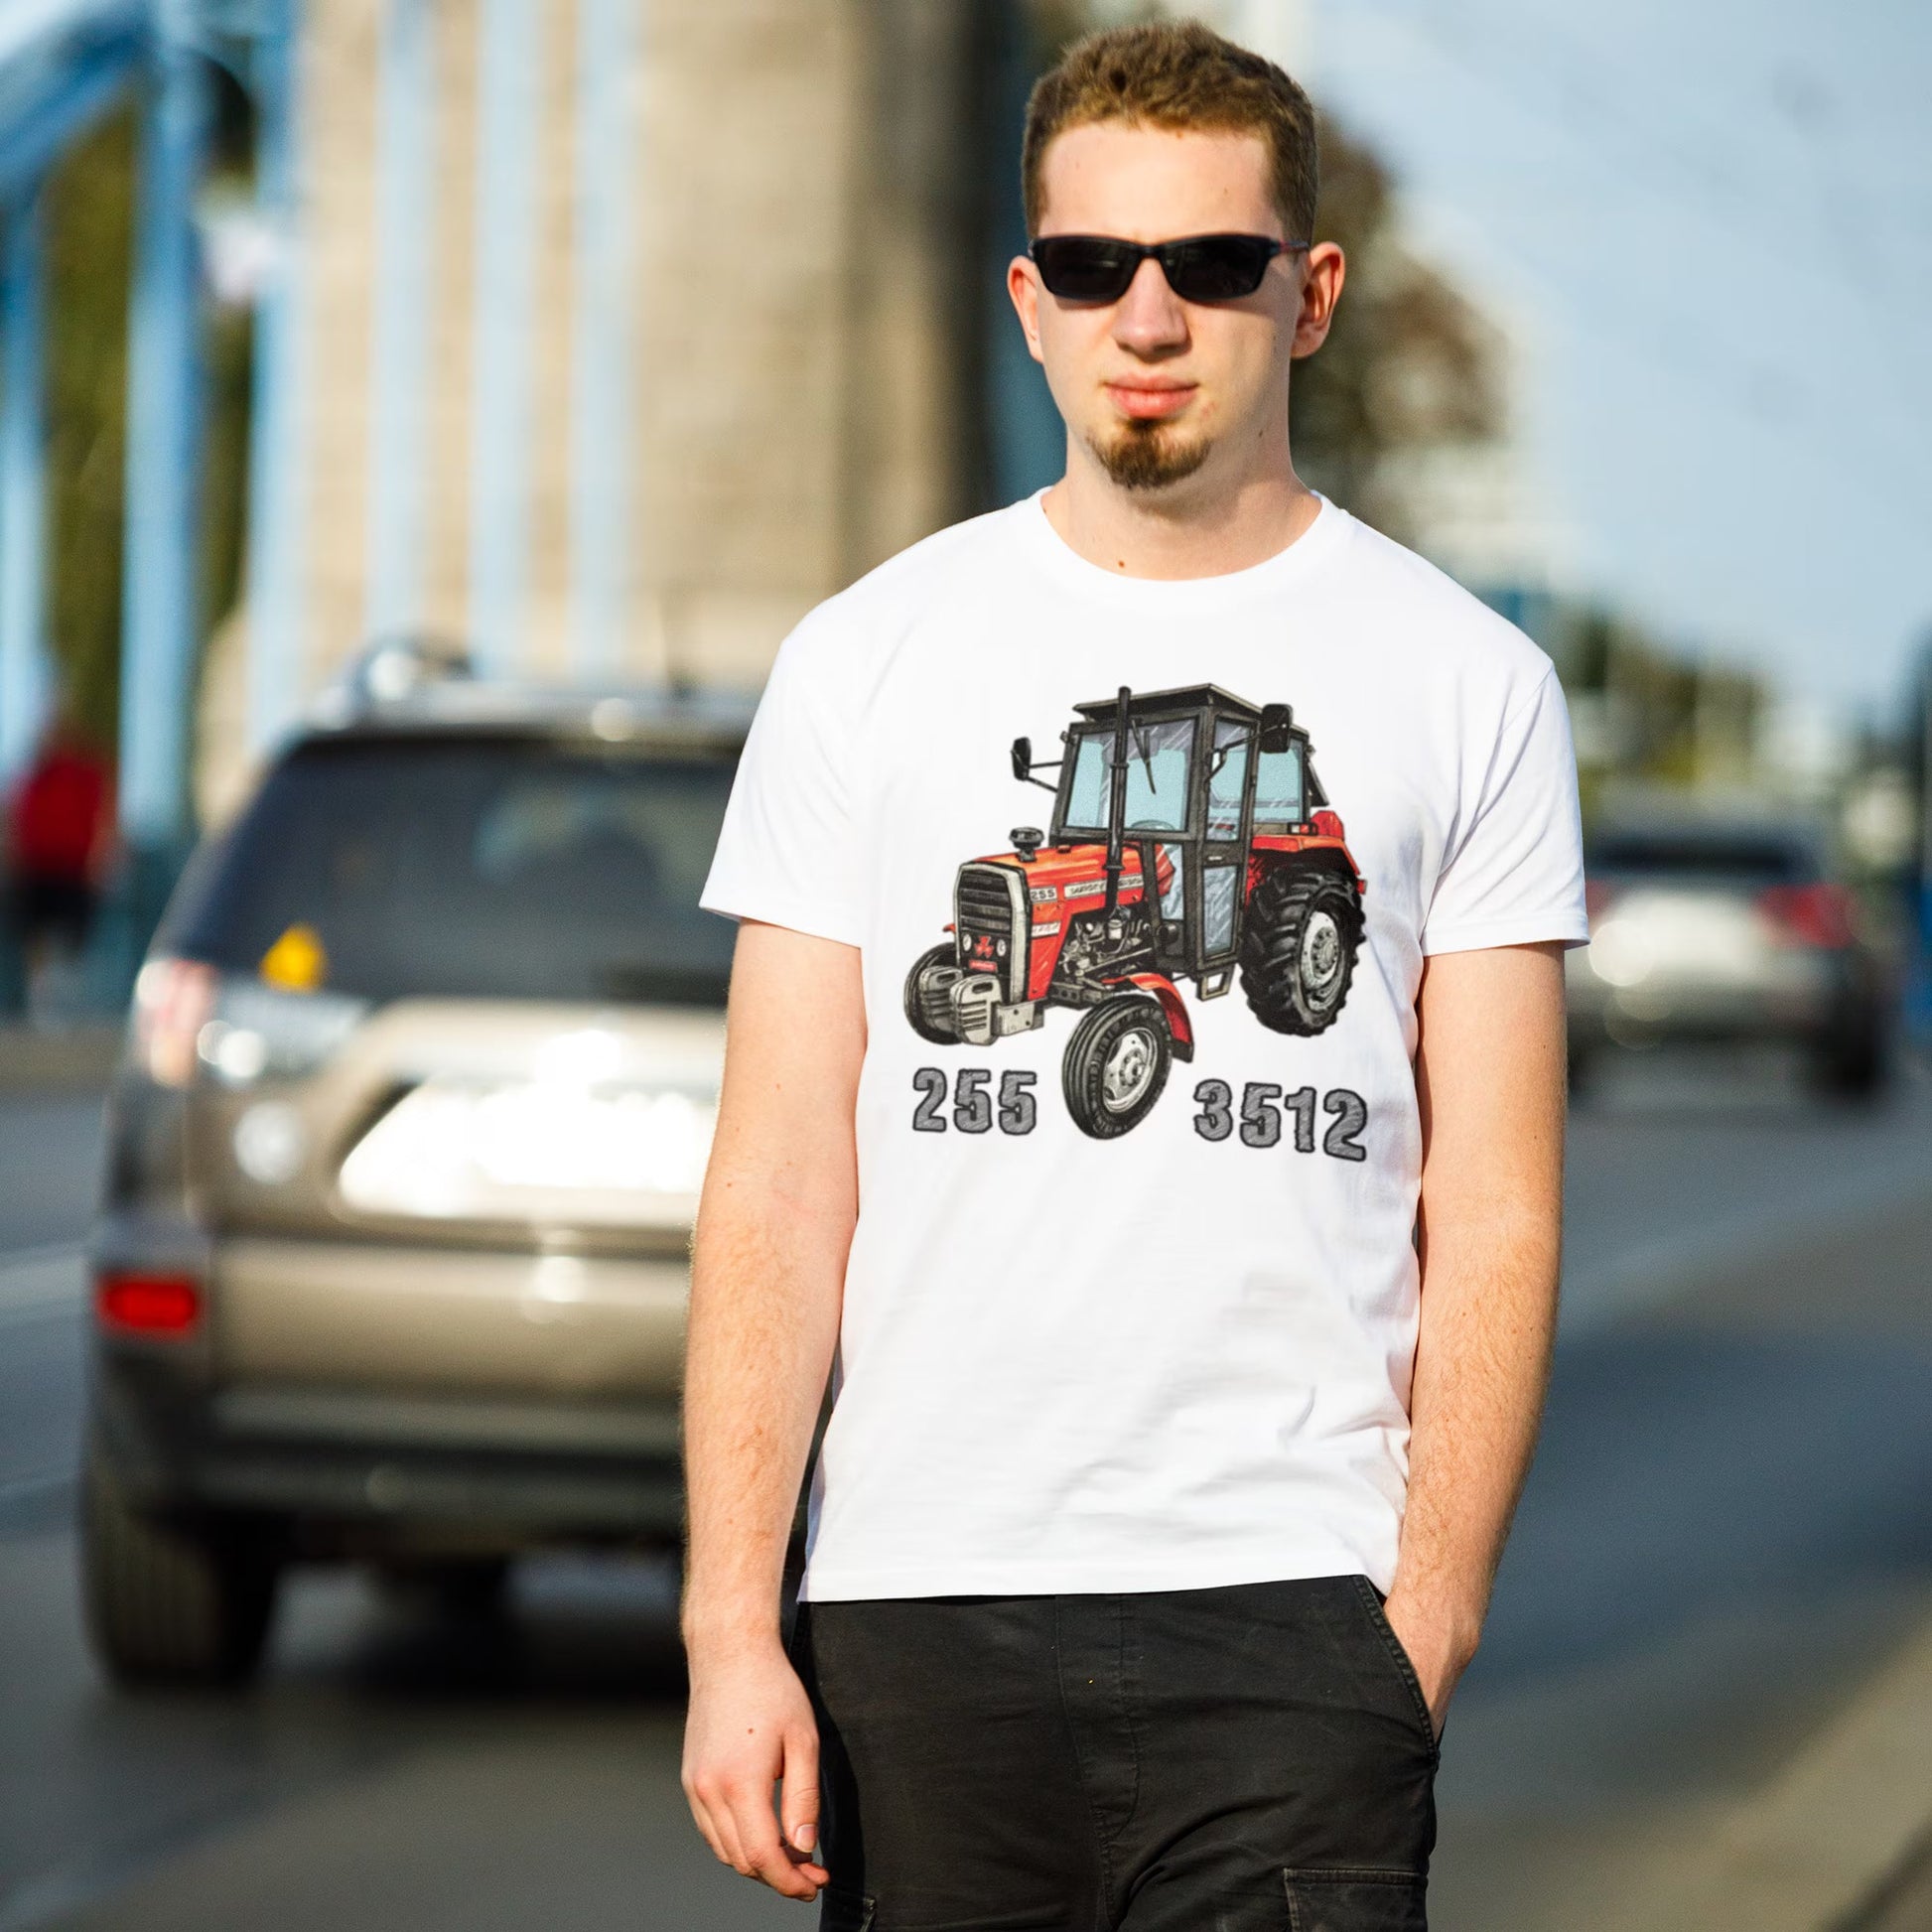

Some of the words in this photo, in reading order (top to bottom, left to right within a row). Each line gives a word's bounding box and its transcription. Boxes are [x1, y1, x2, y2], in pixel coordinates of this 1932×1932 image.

[1032, 888, 1055, 900] 255
[912, 1067, 1036, 1136] 255
[1193, 1079, 1368, 1162] 3512
